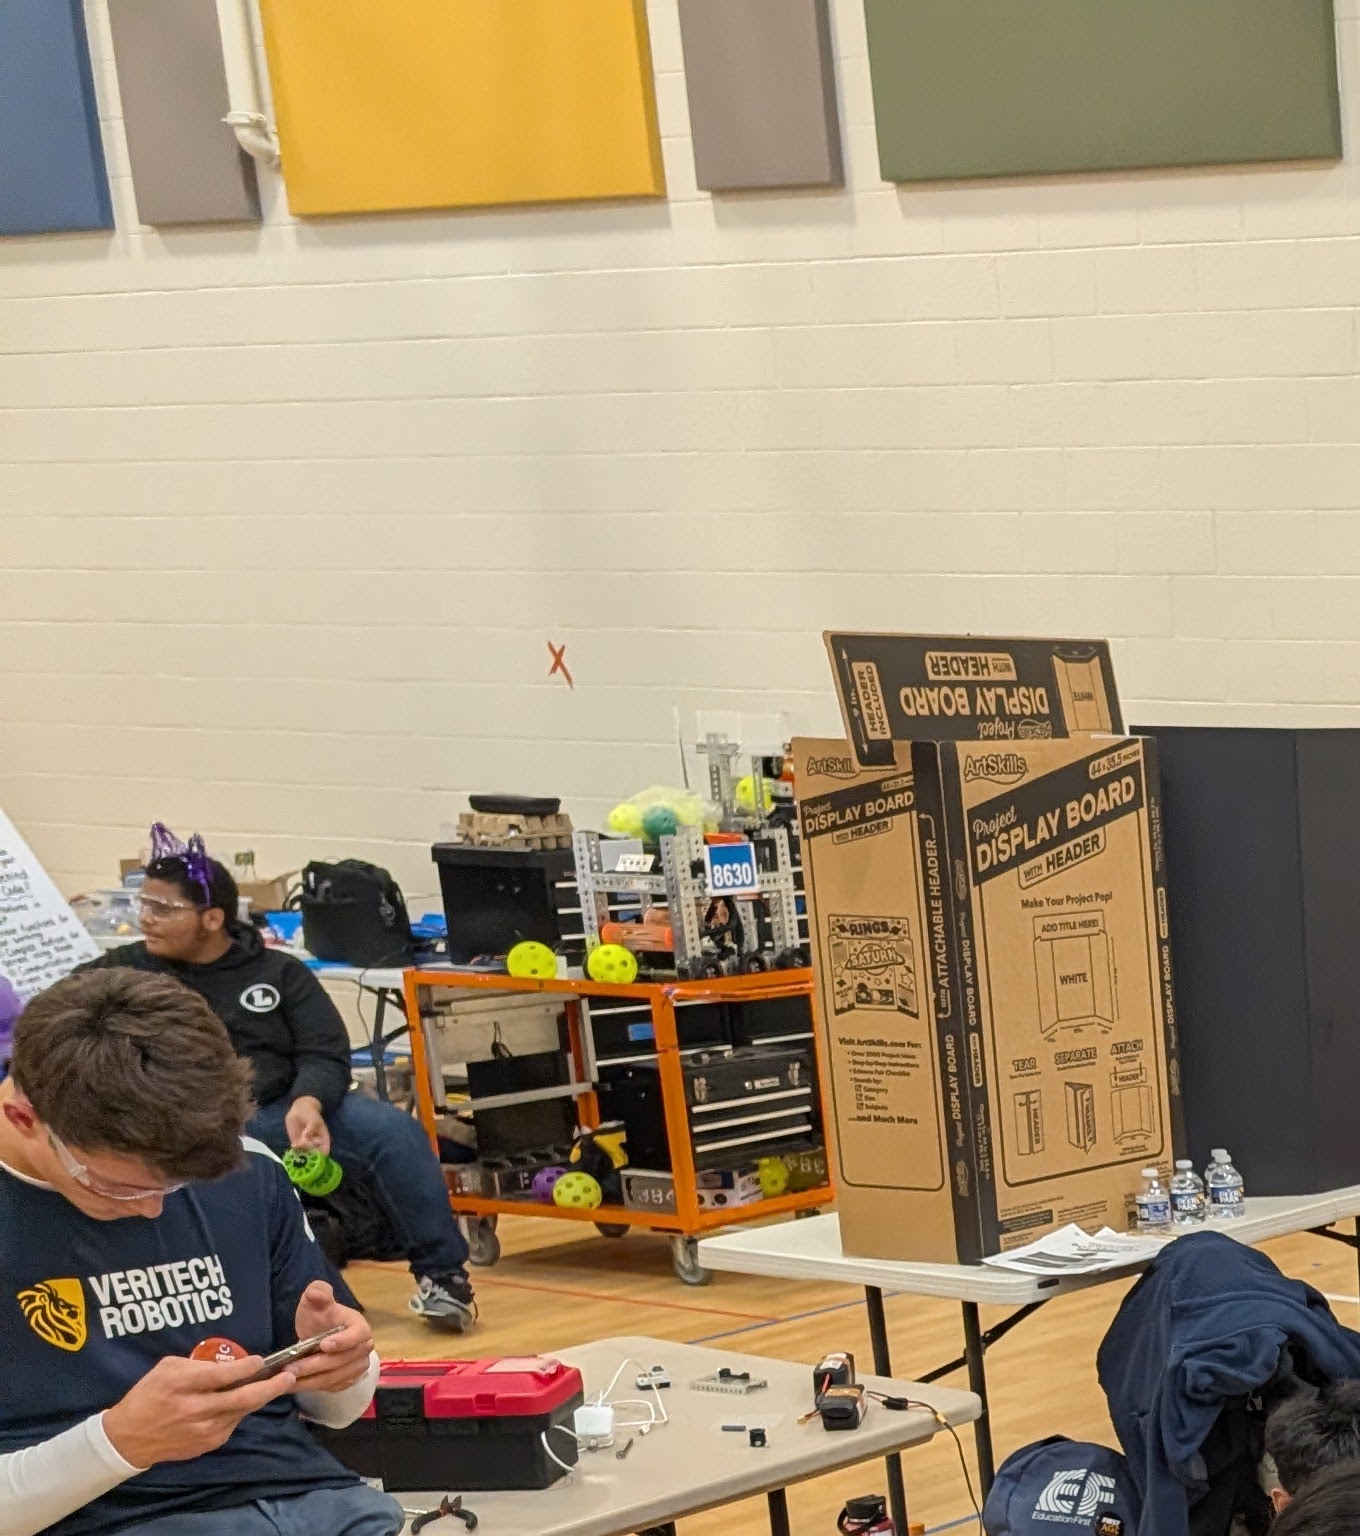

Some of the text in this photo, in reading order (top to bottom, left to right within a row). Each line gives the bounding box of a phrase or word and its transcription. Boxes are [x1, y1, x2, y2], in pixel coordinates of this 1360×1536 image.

[930, 656, 989, 675] HEADER
[857, 669, 878, 733] HEADER
[865, 665, 888, 735] INCLUDED
[900, 687, 1050, 716] DISPLAY BOARD
[964, 755, 1026, 776] ArtSkills
[805, 791, 914, 833] DISPLAY BOARD
[973, 805, 1017, 840] Project
[977, 776, 1135, 873] DISPLAY BOARD
[851, 820, 889, 839] HEADER
[1046, 833, 1100, 873] HEADER
[713, 862, 752, 887] 8630
[925, 839, 950, 988] ATTACHABLE HEADER
[1021, 891, 1112, 909] Make Your Project Pop!
[849, 921, 890, 936] RINGS
[1042, 923, 1057, 932] ADD
[1059, 921, 1077, 931] TITLE
[849, 948, 898, 968] SATURN
[962, 939, 976, 1026] DISPLAY BOARD
[1060, 973, 1088, 985] WHITE
[1162, 945, 1176, 1025] DISPLAY BOARD
[1055, 1047, 1097, 1065] SEPARATE
[1110, 1039, 1143, 1055] ATTACH
[946, 1034, 961, 1120] DISPLAY BOARD
[1013, 1057, 1036, 1071] TEAR
[873, 1115, 918, 1125] Much More
[89, 1254, 225, 1302] VERITECH
[100, 1286, 234, 1339] ROBOTICS
[1035, 1469, 1115, 1516] EF
